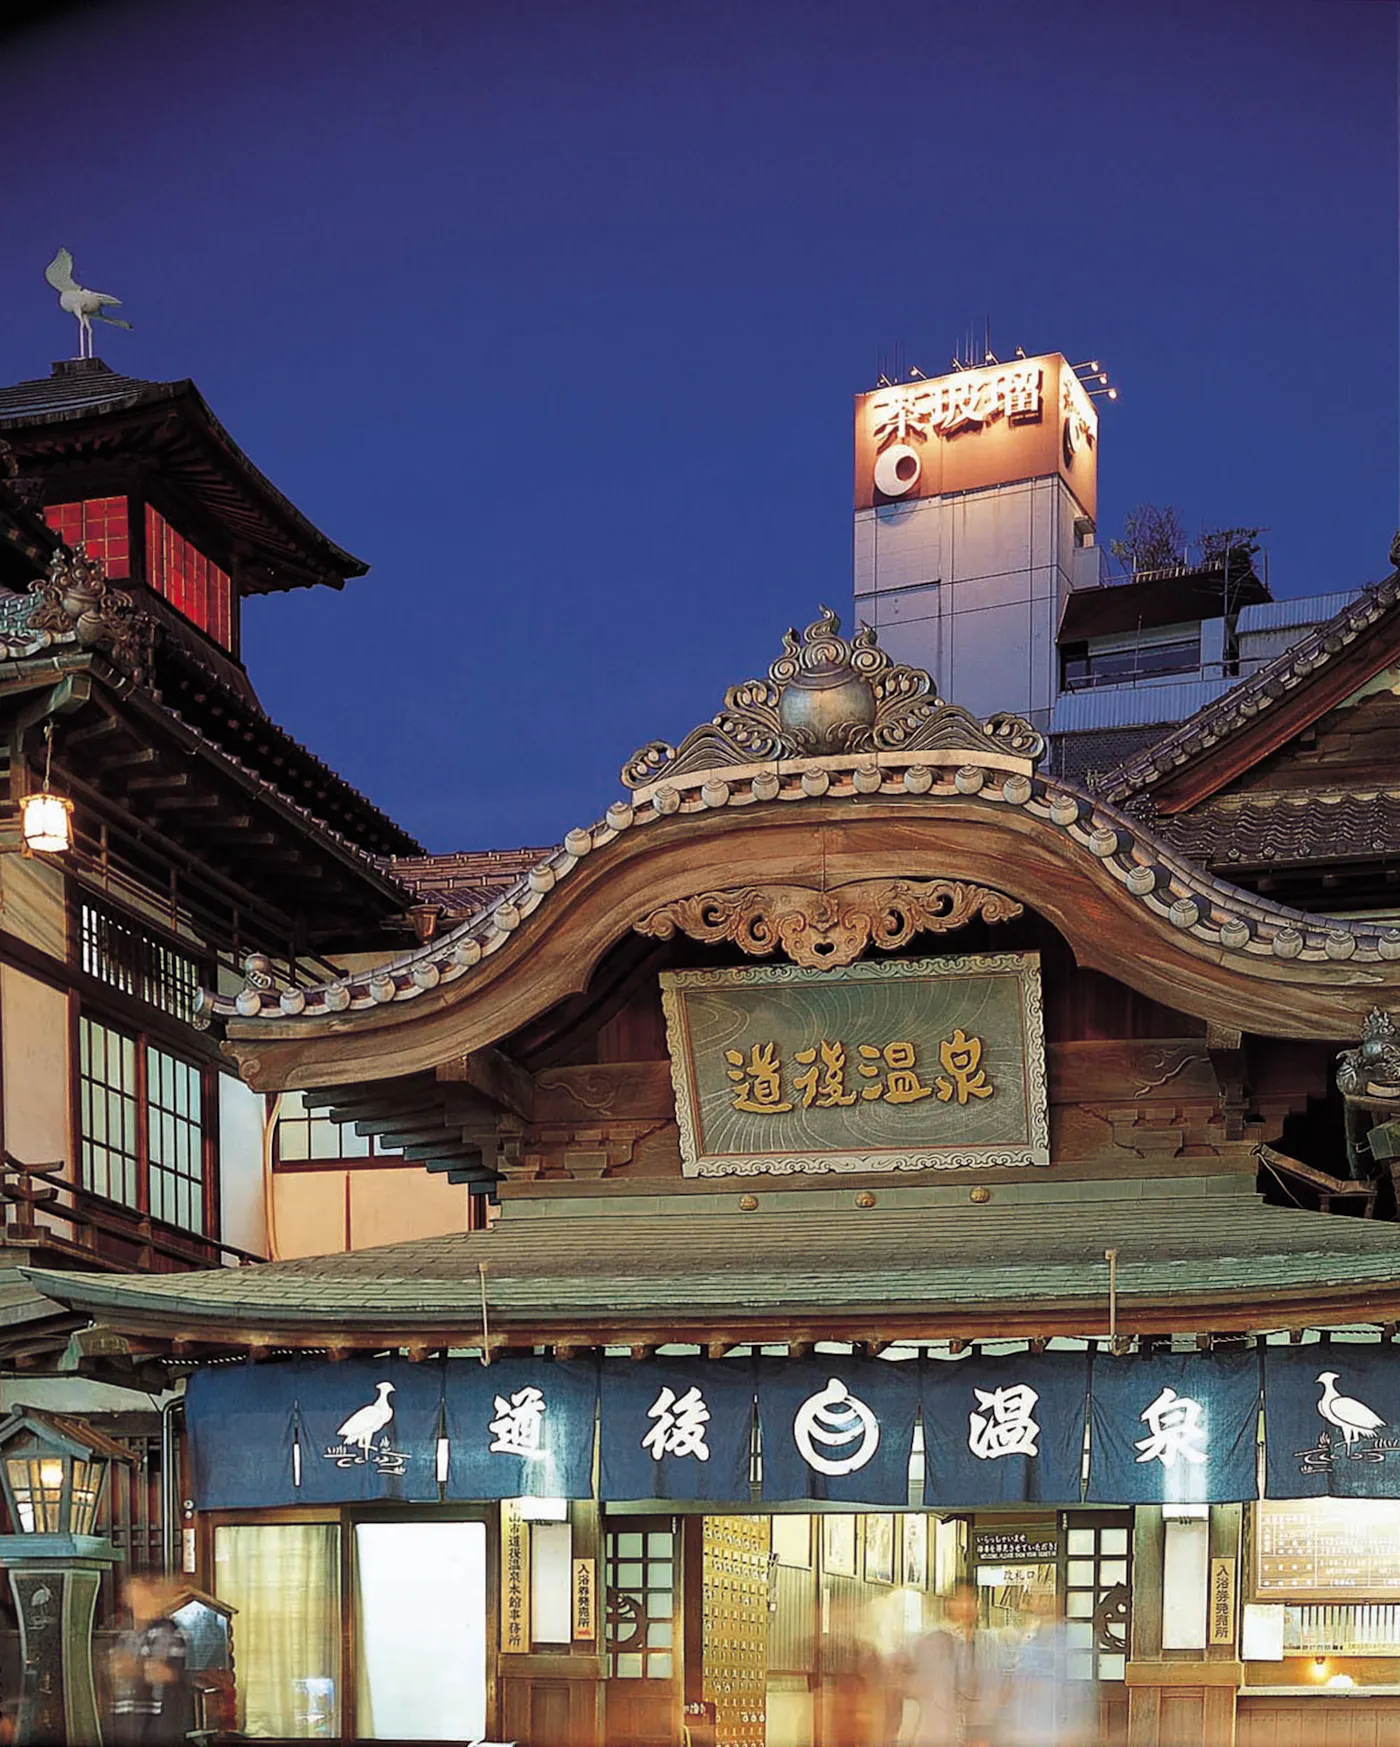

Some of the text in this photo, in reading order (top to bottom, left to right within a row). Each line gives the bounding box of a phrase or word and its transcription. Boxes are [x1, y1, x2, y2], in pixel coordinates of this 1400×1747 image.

[725, 1028, 993, 1114] 道後温泉
[578, 1564, 590, 1628] 入浴券発売所
[1215, 1564, 1230, 1639] 入浴券発売所
